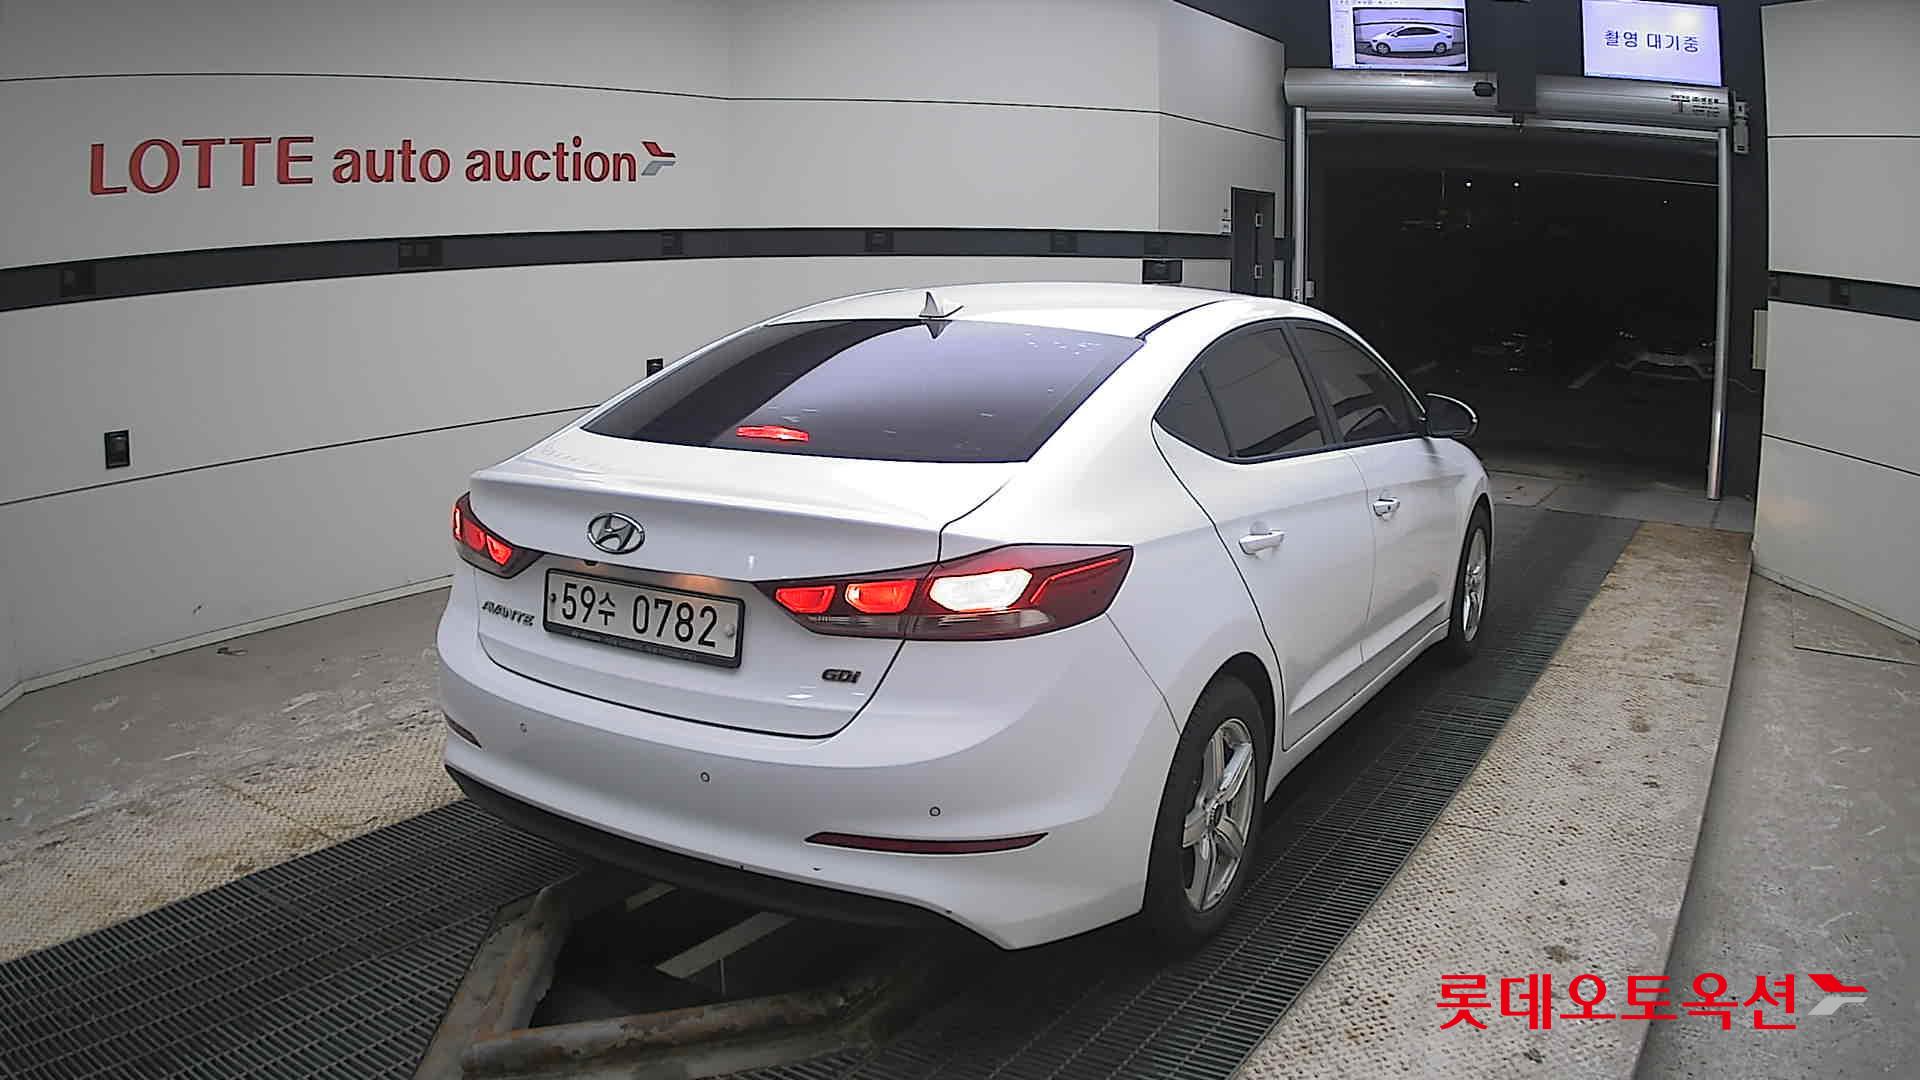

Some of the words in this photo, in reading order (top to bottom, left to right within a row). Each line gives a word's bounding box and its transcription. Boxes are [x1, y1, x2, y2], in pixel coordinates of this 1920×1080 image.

[1646, 33, 1699, 53] 대기중
[89, 136, 314, 196] LOTTE
[332, 139, 451, 184] auto
[465, 135, 638, 184] auction
[561, 582, 616, 627] 59수
[632, 595, 719, 648] 0782
